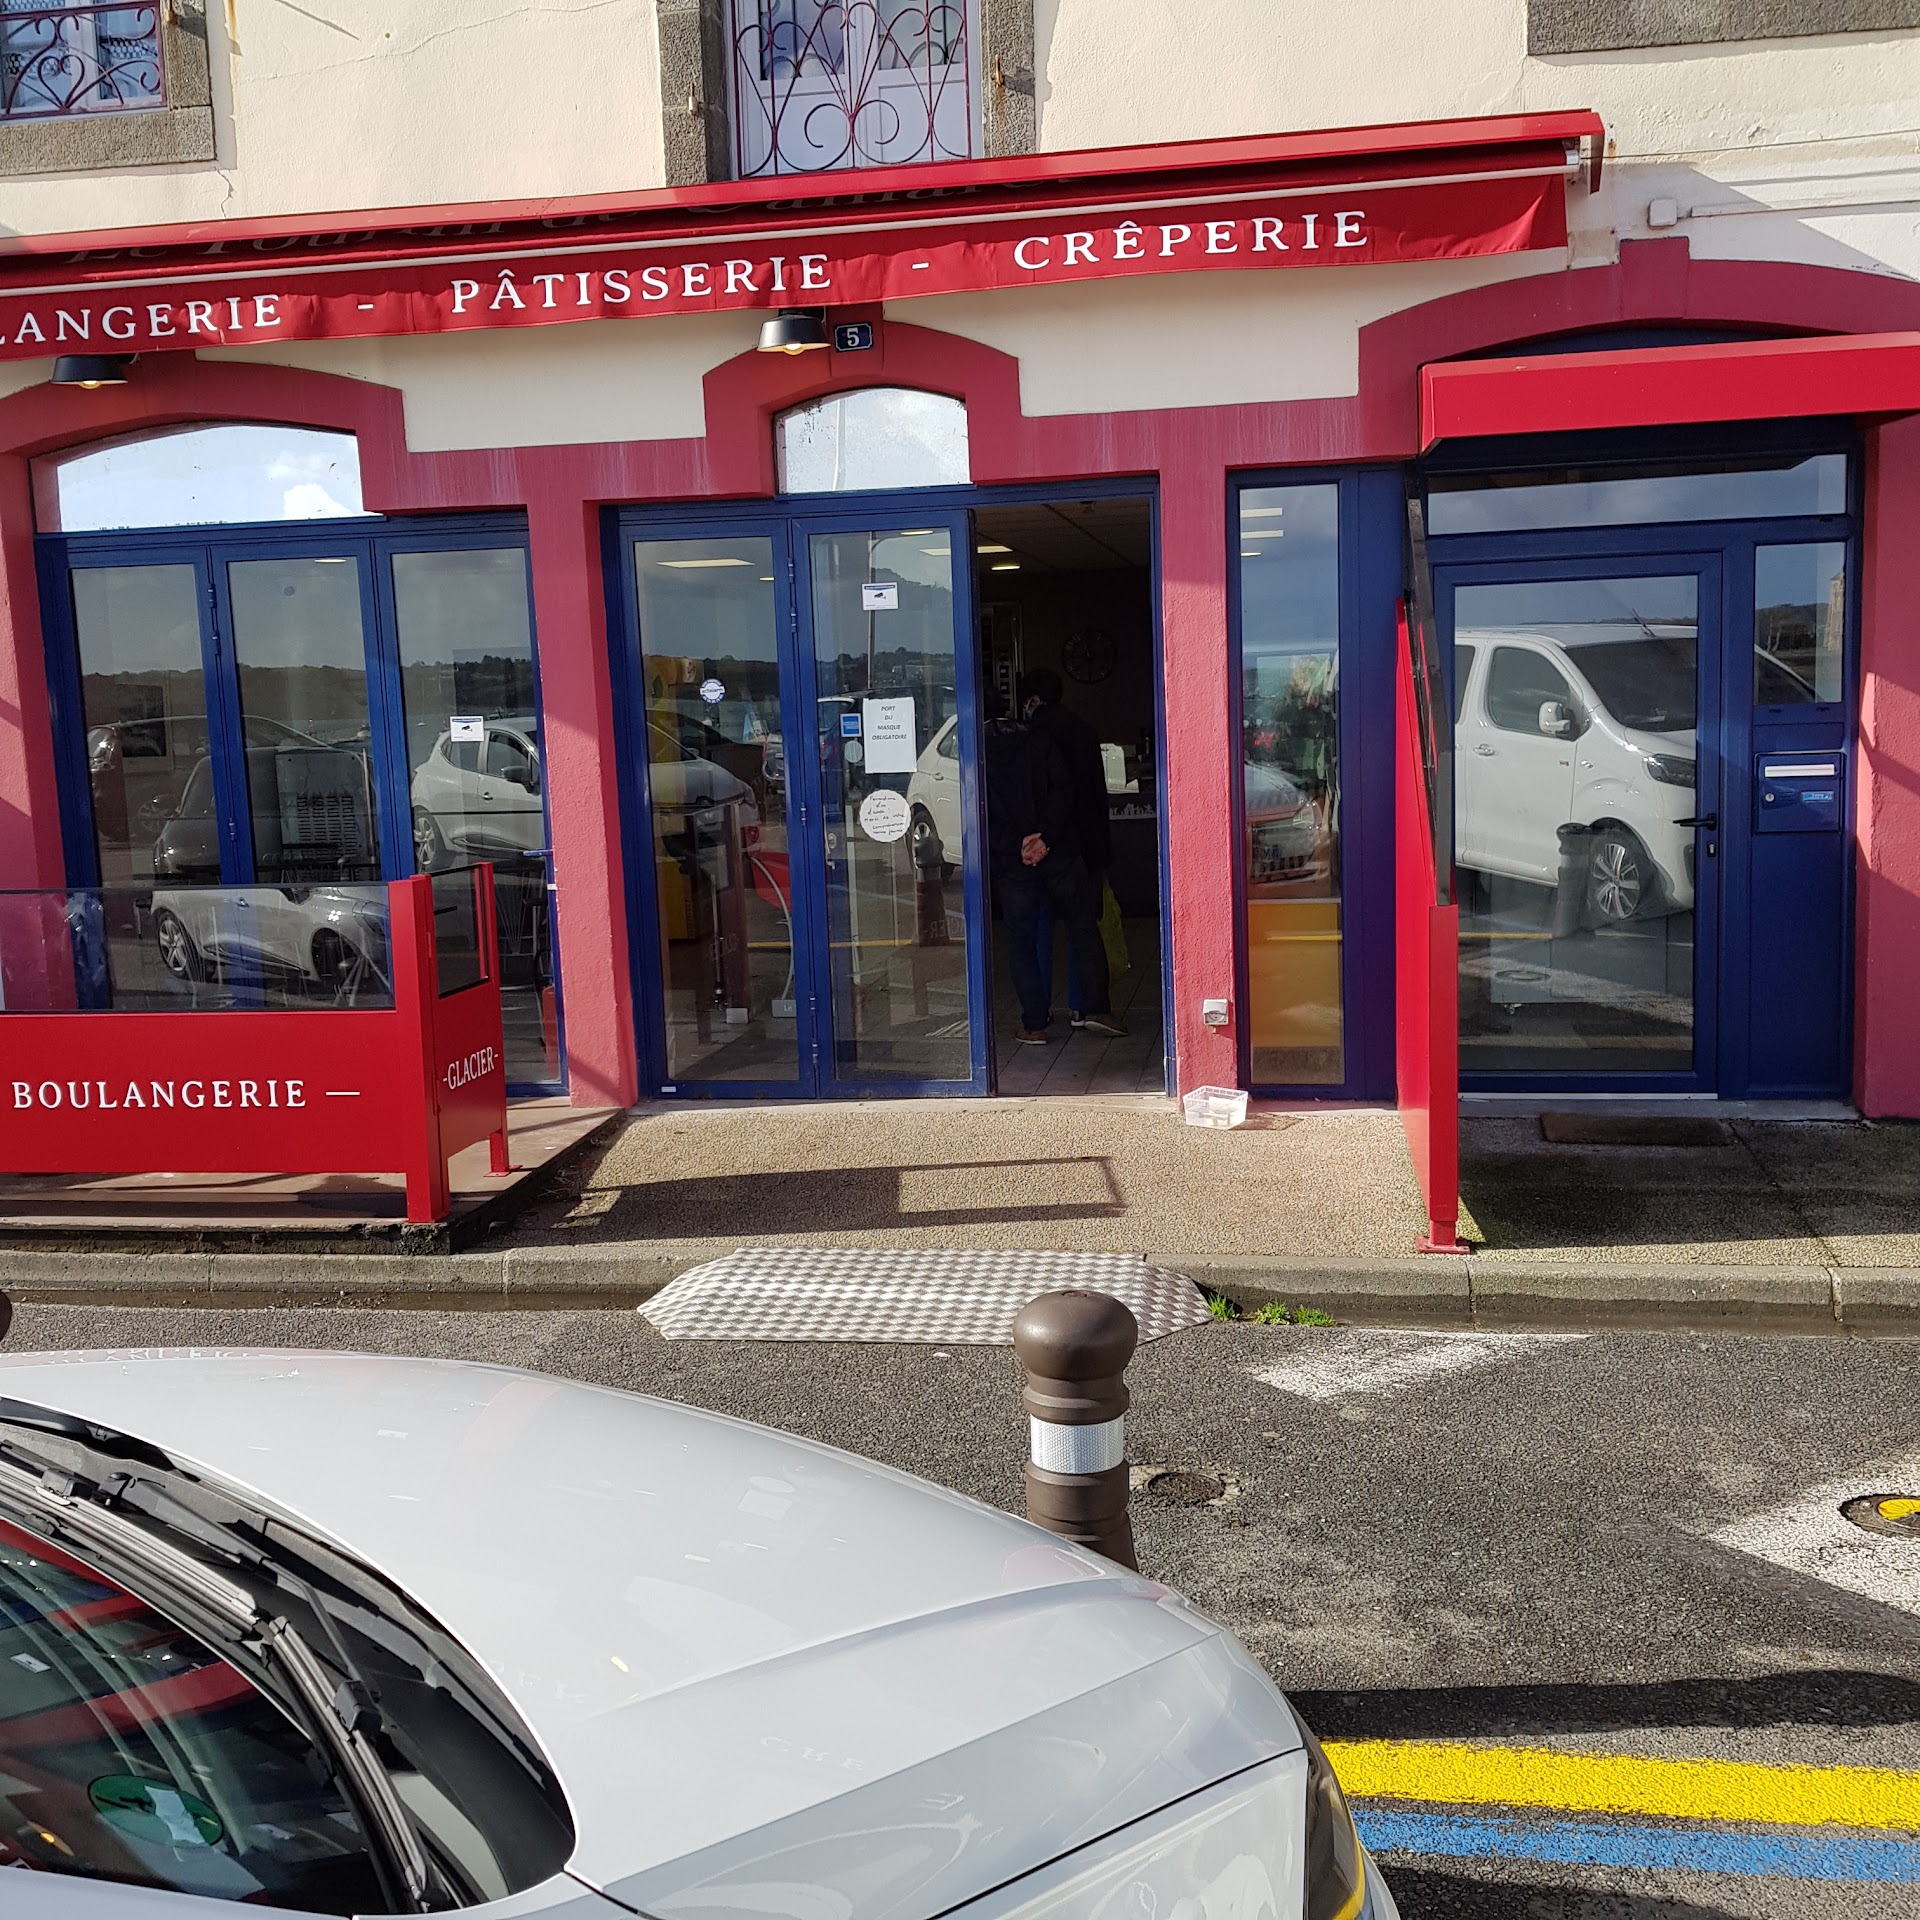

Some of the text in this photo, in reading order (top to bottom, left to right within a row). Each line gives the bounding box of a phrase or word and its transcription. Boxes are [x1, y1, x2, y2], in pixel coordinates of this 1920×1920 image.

[0, 294, 282, 345] ANGERIE
[450, 254, 831, 314] PÂTISSERIE
[1013, 210, 1368, 270] CRÊPERIE
[846, 327, 860, 347] 5
[872, 733, 907, 741] OBLIGATOIRE
[11, 1079, 306, 1109] BOULANGERIE
